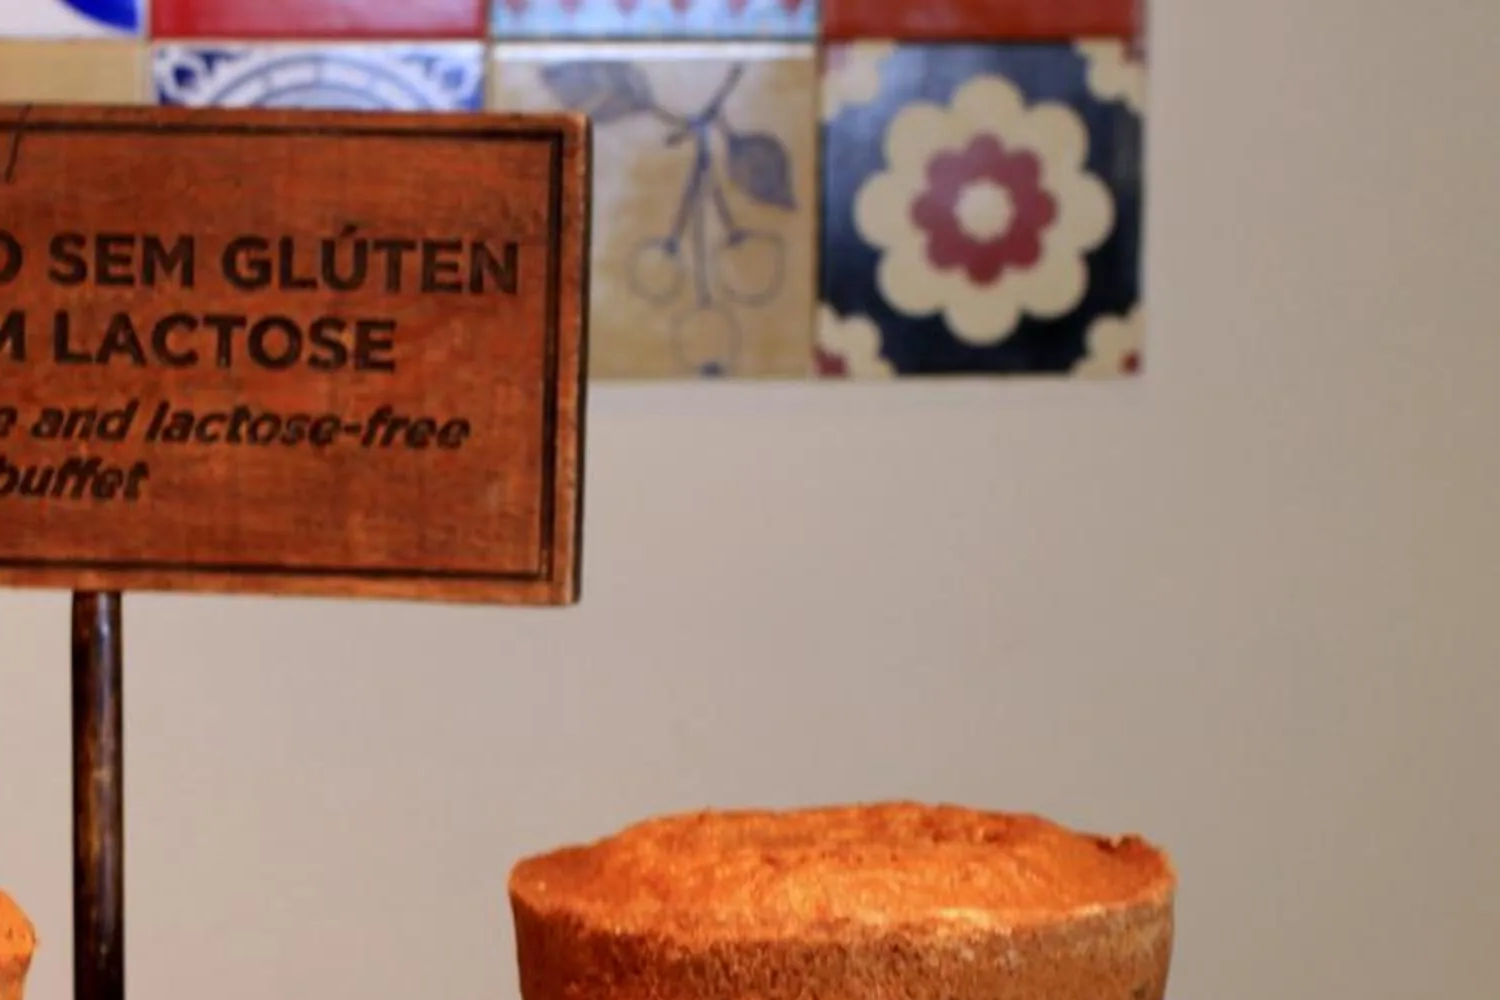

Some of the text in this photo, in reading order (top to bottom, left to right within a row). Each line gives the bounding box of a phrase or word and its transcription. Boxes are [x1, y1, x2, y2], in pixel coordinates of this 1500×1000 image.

[48, 232, 195, 288] SEM
[221, 224, 519, 296] GLÚTEN
[53, 311, 397, 373] LACTOSE
[31, 398, 139, 442] and
[144, 401, 471, 450] lactose-free
